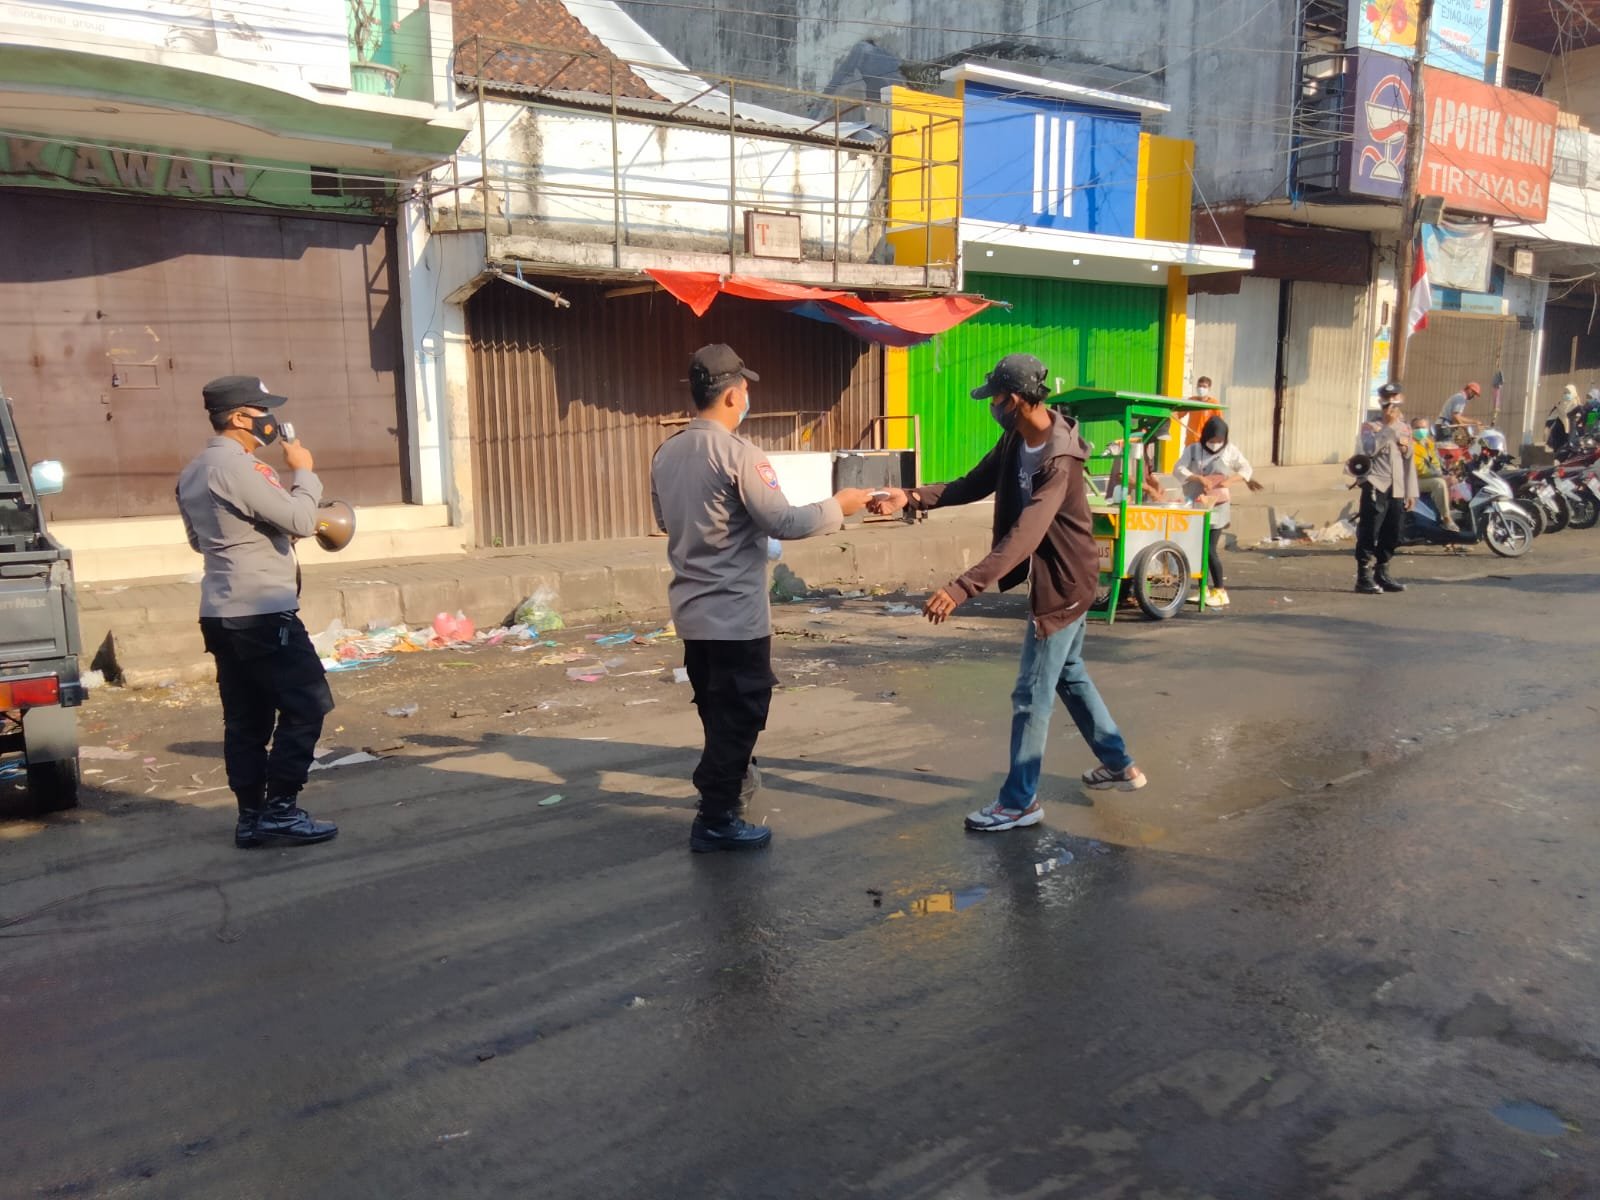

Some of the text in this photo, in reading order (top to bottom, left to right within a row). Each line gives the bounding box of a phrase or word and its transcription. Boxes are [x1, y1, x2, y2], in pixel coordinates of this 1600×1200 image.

[1429, 97, 1552, 168] APOTEK SEHAT
[1428, 162, 1543, 210] TIRTAYASA
